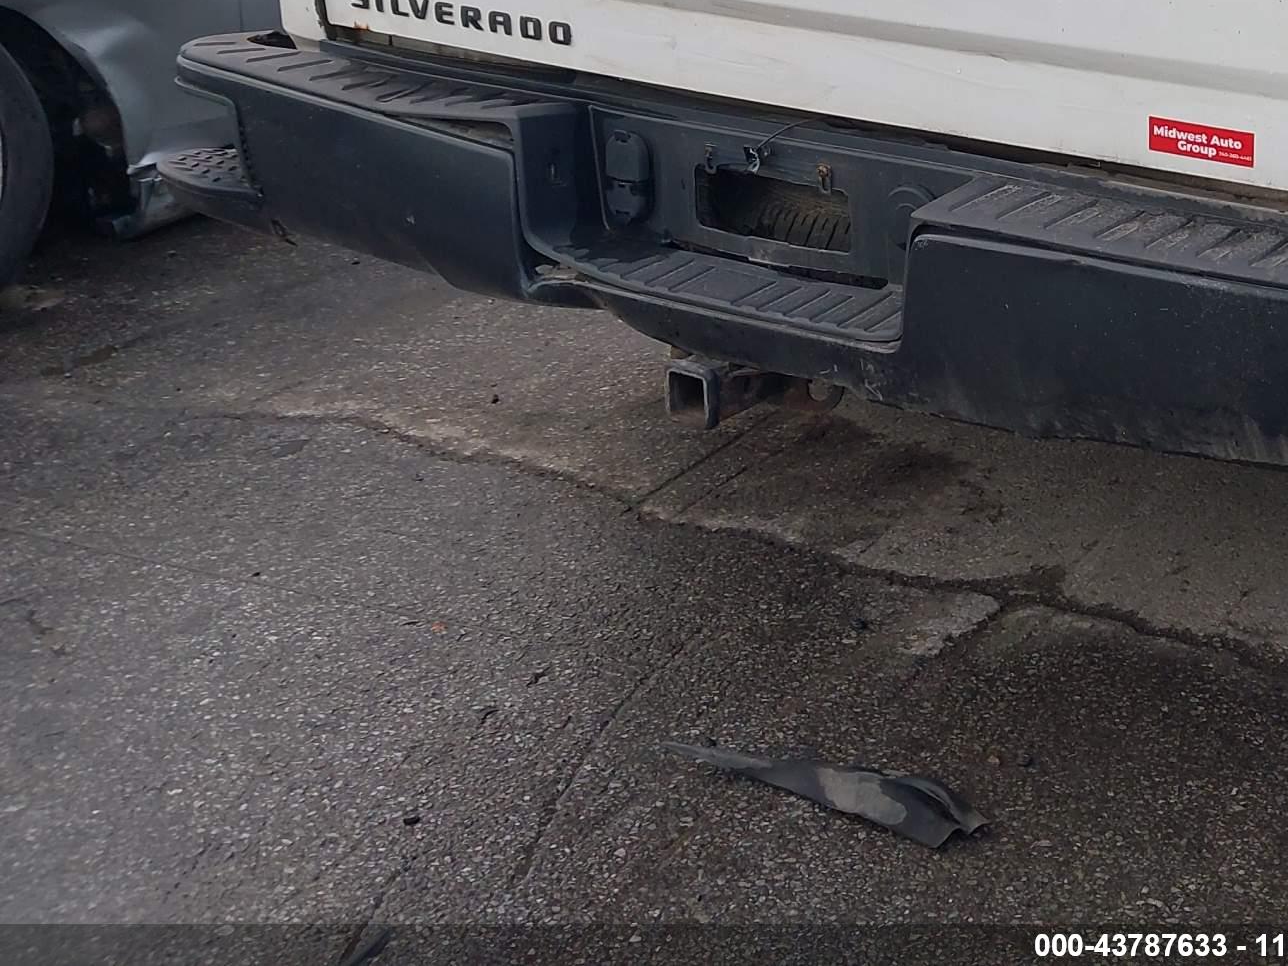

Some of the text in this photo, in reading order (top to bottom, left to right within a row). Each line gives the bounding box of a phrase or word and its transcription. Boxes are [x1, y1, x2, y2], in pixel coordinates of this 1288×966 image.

[1153, 125, 1242, 150] Midwest Auto
[1177, 140, 1217, 158] Group
